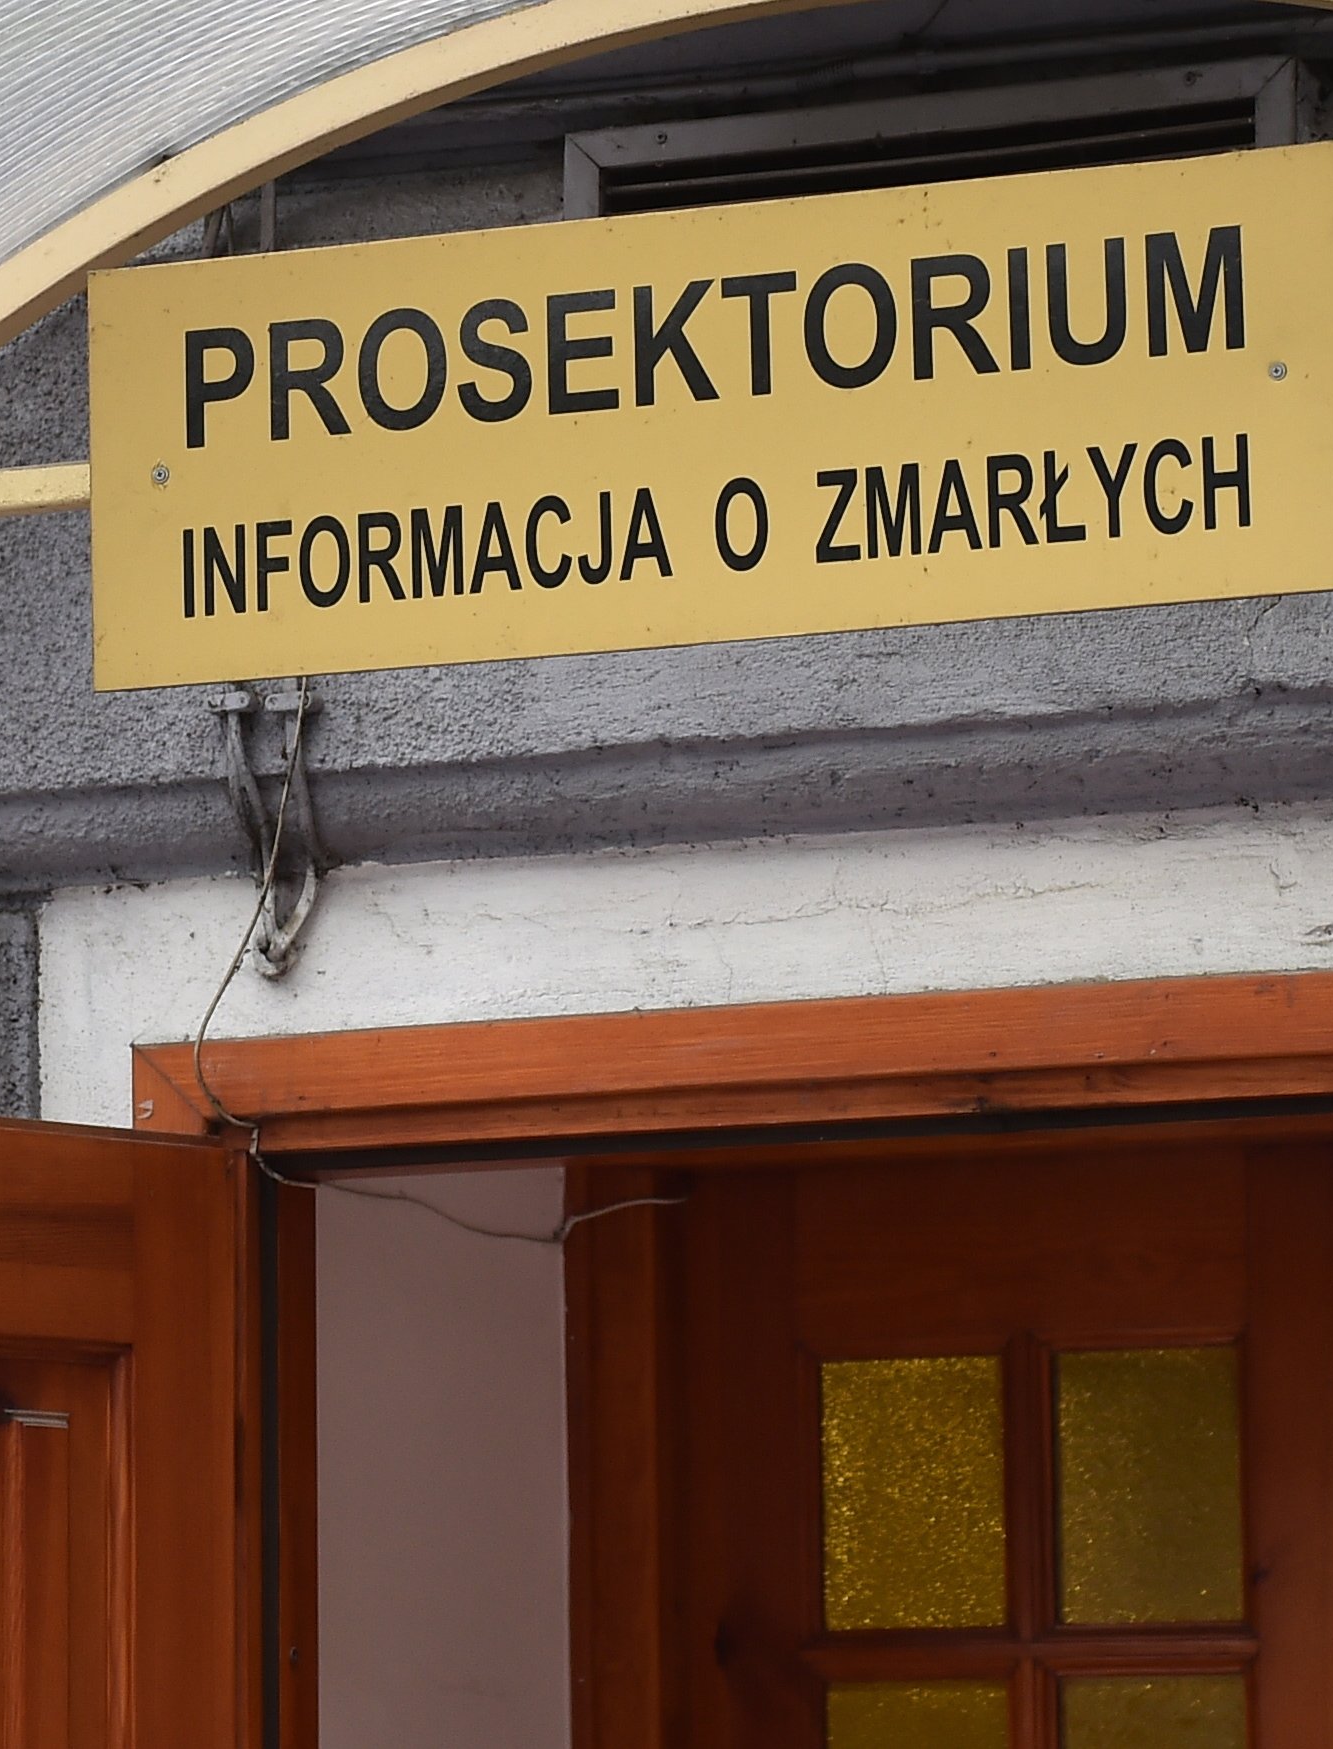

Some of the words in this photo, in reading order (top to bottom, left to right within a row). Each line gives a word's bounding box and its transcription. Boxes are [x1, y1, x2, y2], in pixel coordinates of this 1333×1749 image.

[184, 224, 1245, 449] PROSEKTORIUM
[182, 487, 674, 619] INFORMACJA
[714, 477, 769, 572] O
[815, 433, 1251, 564] ZMARŁYCH
